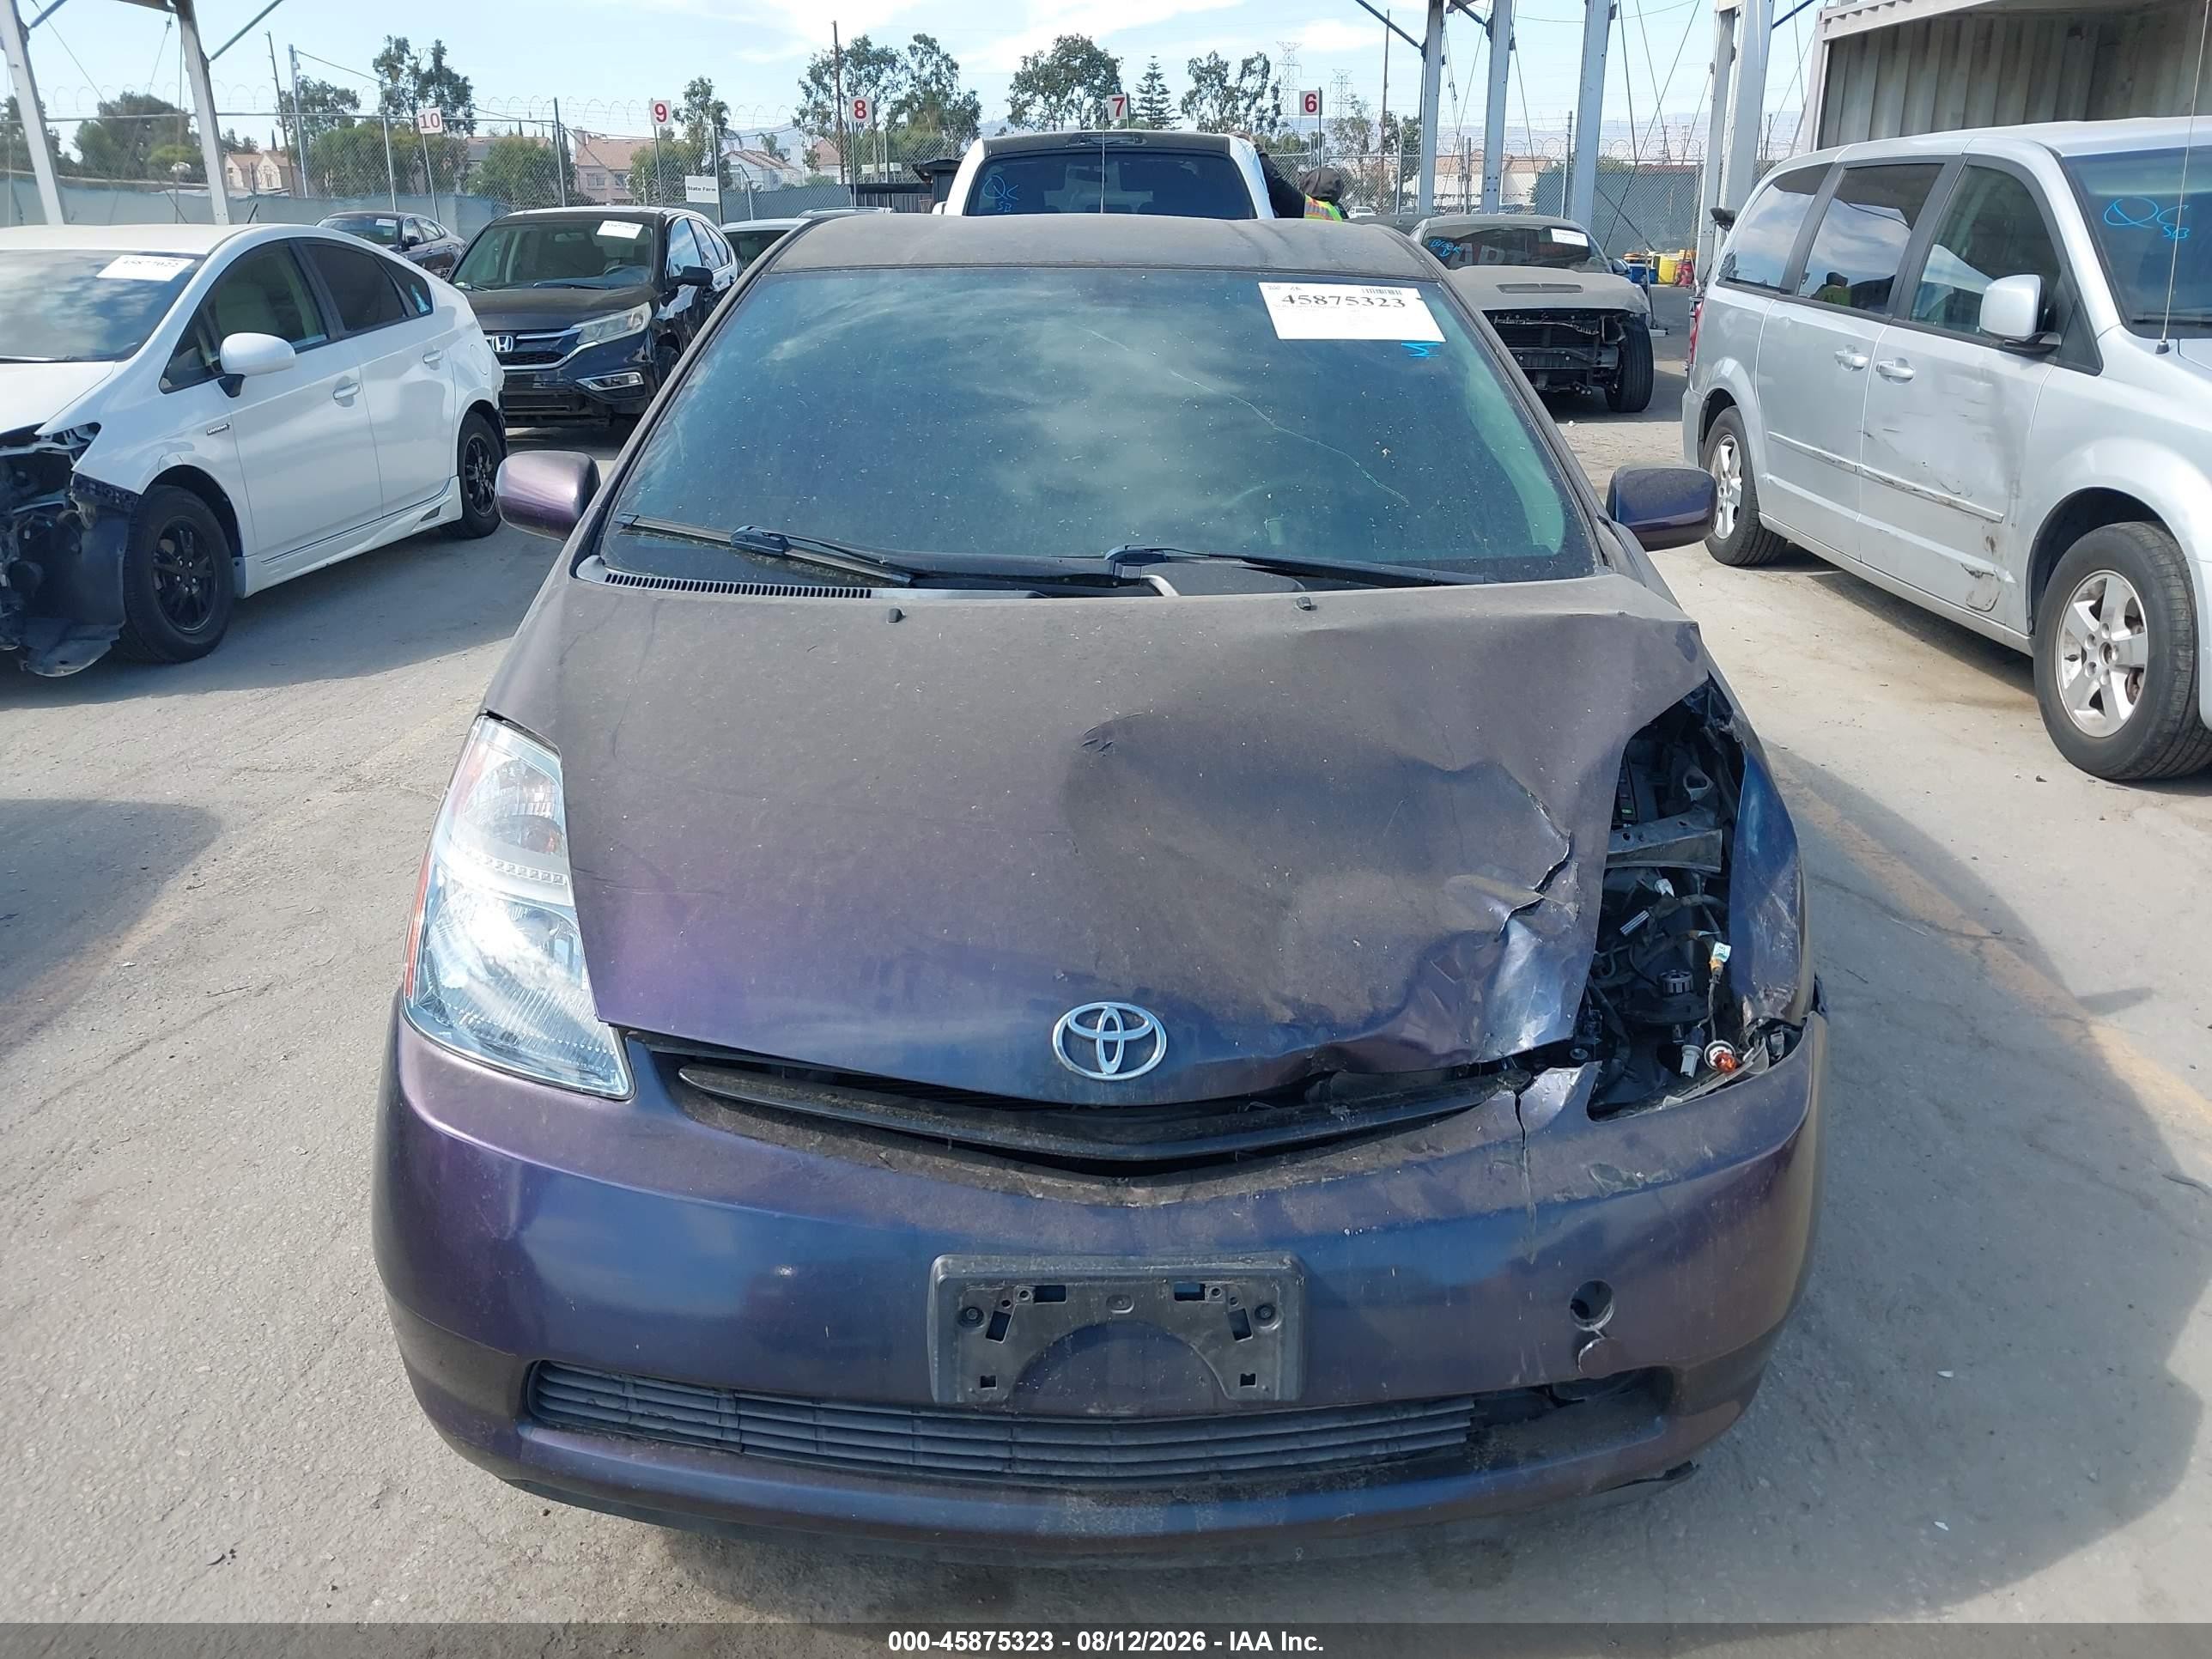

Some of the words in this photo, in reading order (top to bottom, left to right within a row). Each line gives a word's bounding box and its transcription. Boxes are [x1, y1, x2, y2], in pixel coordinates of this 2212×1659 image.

[854, 100, 866, 118] 8
[1112, 97, 1125, 117] 7
[1305, 94, 1317, 112] 6
[419, 112, 441, 129] 10
[655, 103, 667, 122] 9
[1280, 294, 1406, 307] 45875323
